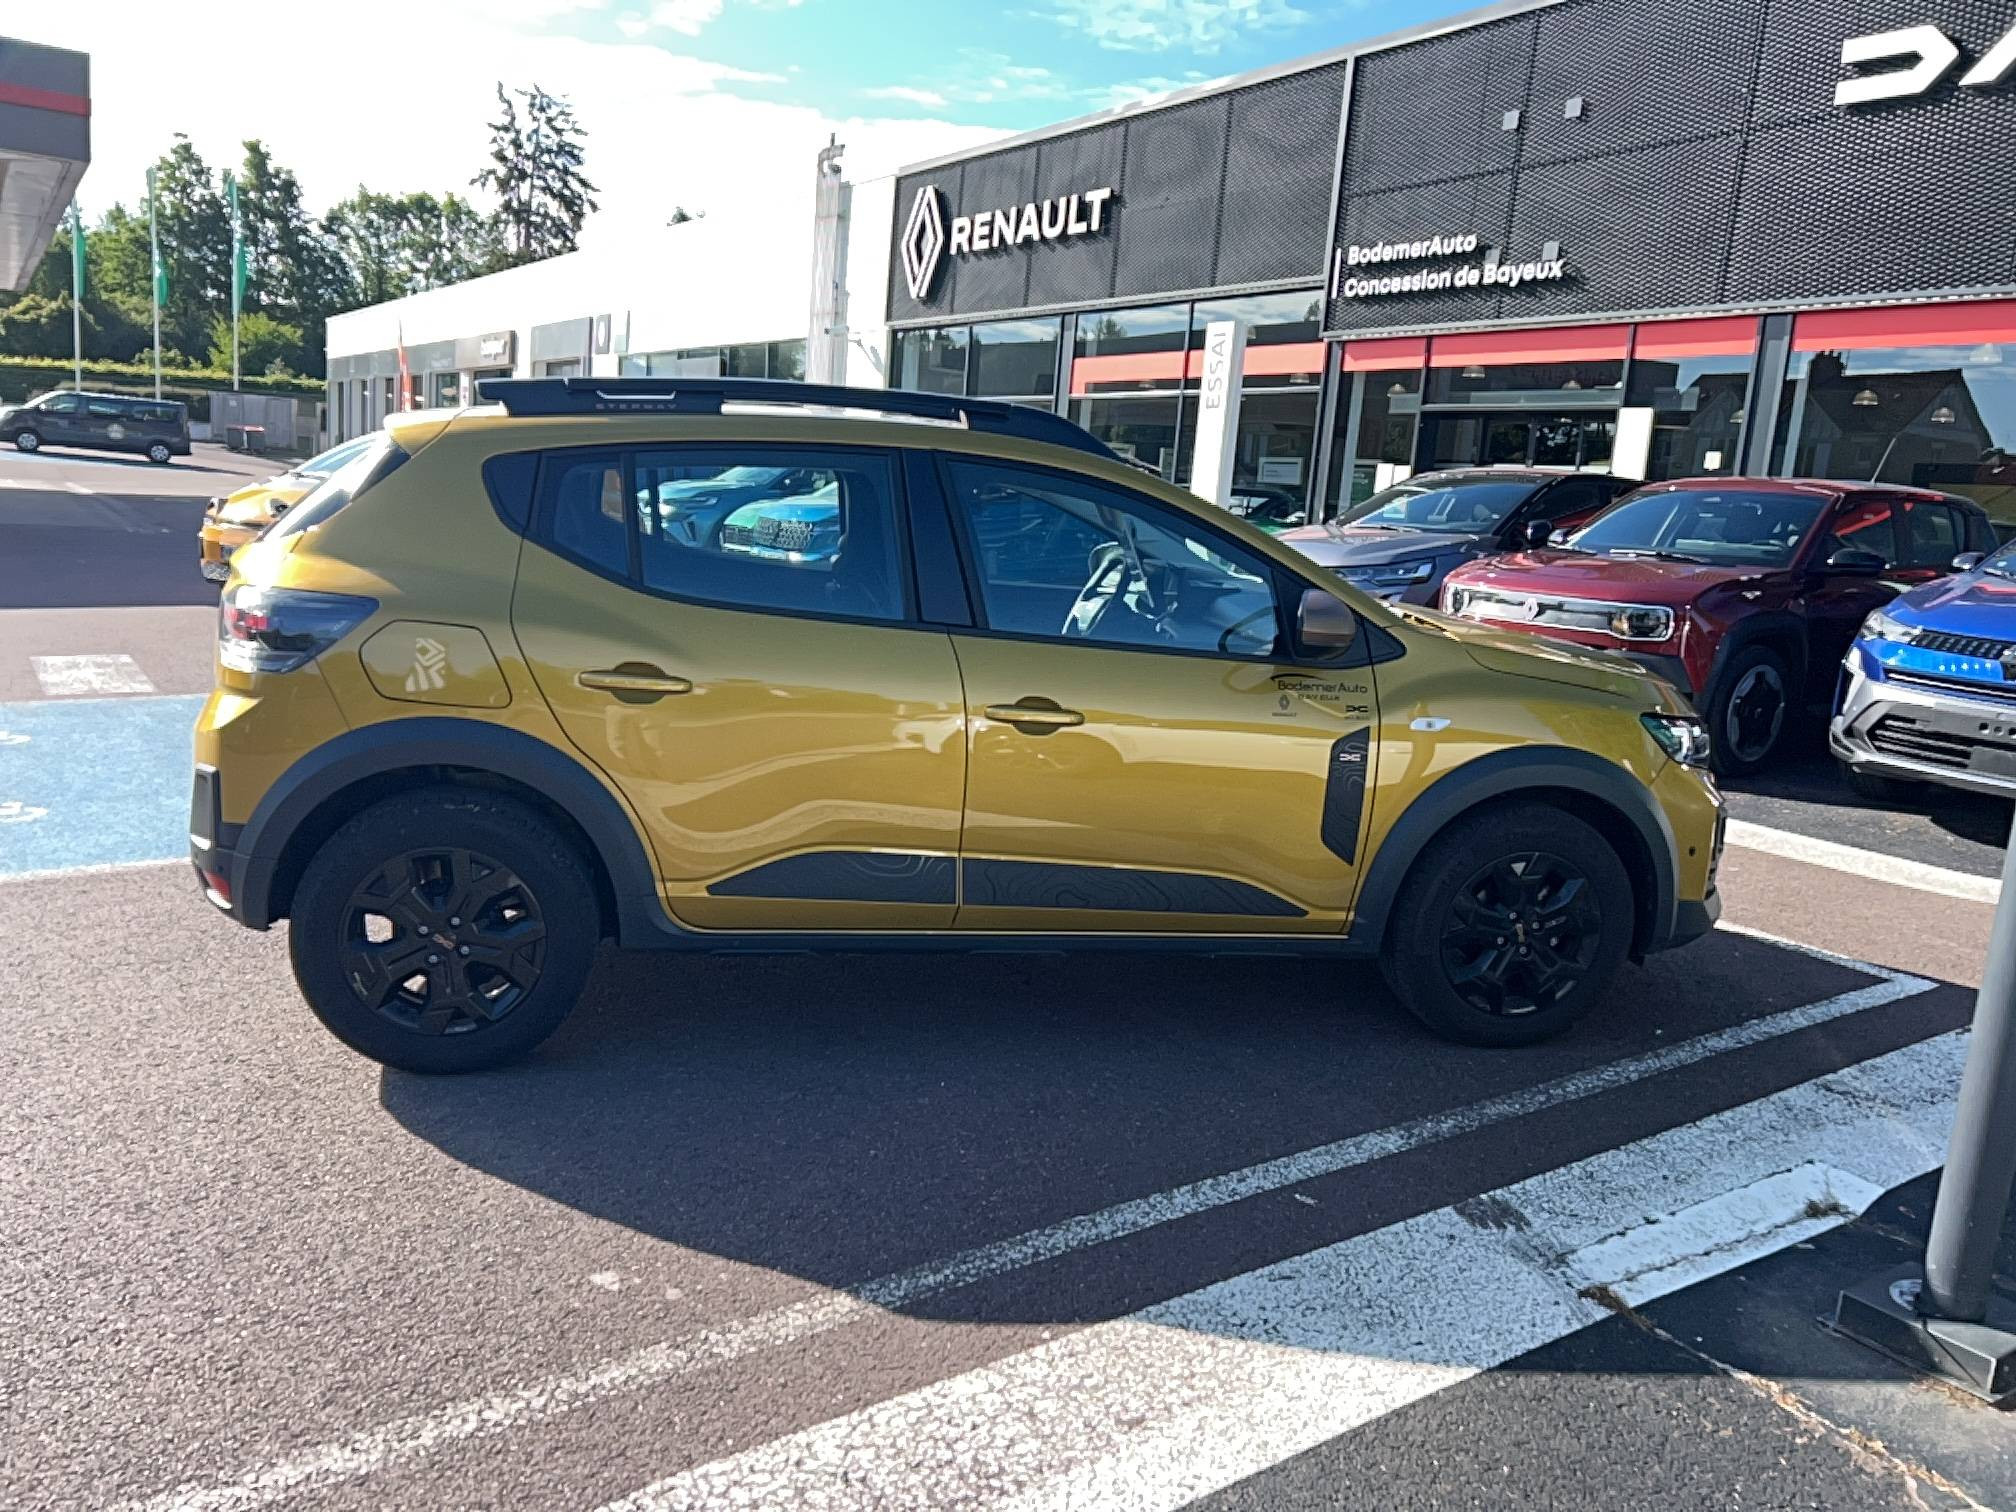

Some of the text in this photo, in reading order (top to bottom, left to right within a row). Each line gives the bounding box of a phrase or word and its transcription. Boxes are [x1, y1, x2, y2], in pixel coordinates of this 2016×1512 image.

[950, 187, 1112, 255] RENAULT
[1346, 233, 1479, 266] BodemerAuto
[1343, 258, 1565, 298] Concession de Bayeux
[1205, 331, 1226, 410] ESSAI
[1277, 679, 1369, 694] BodemerAuto
